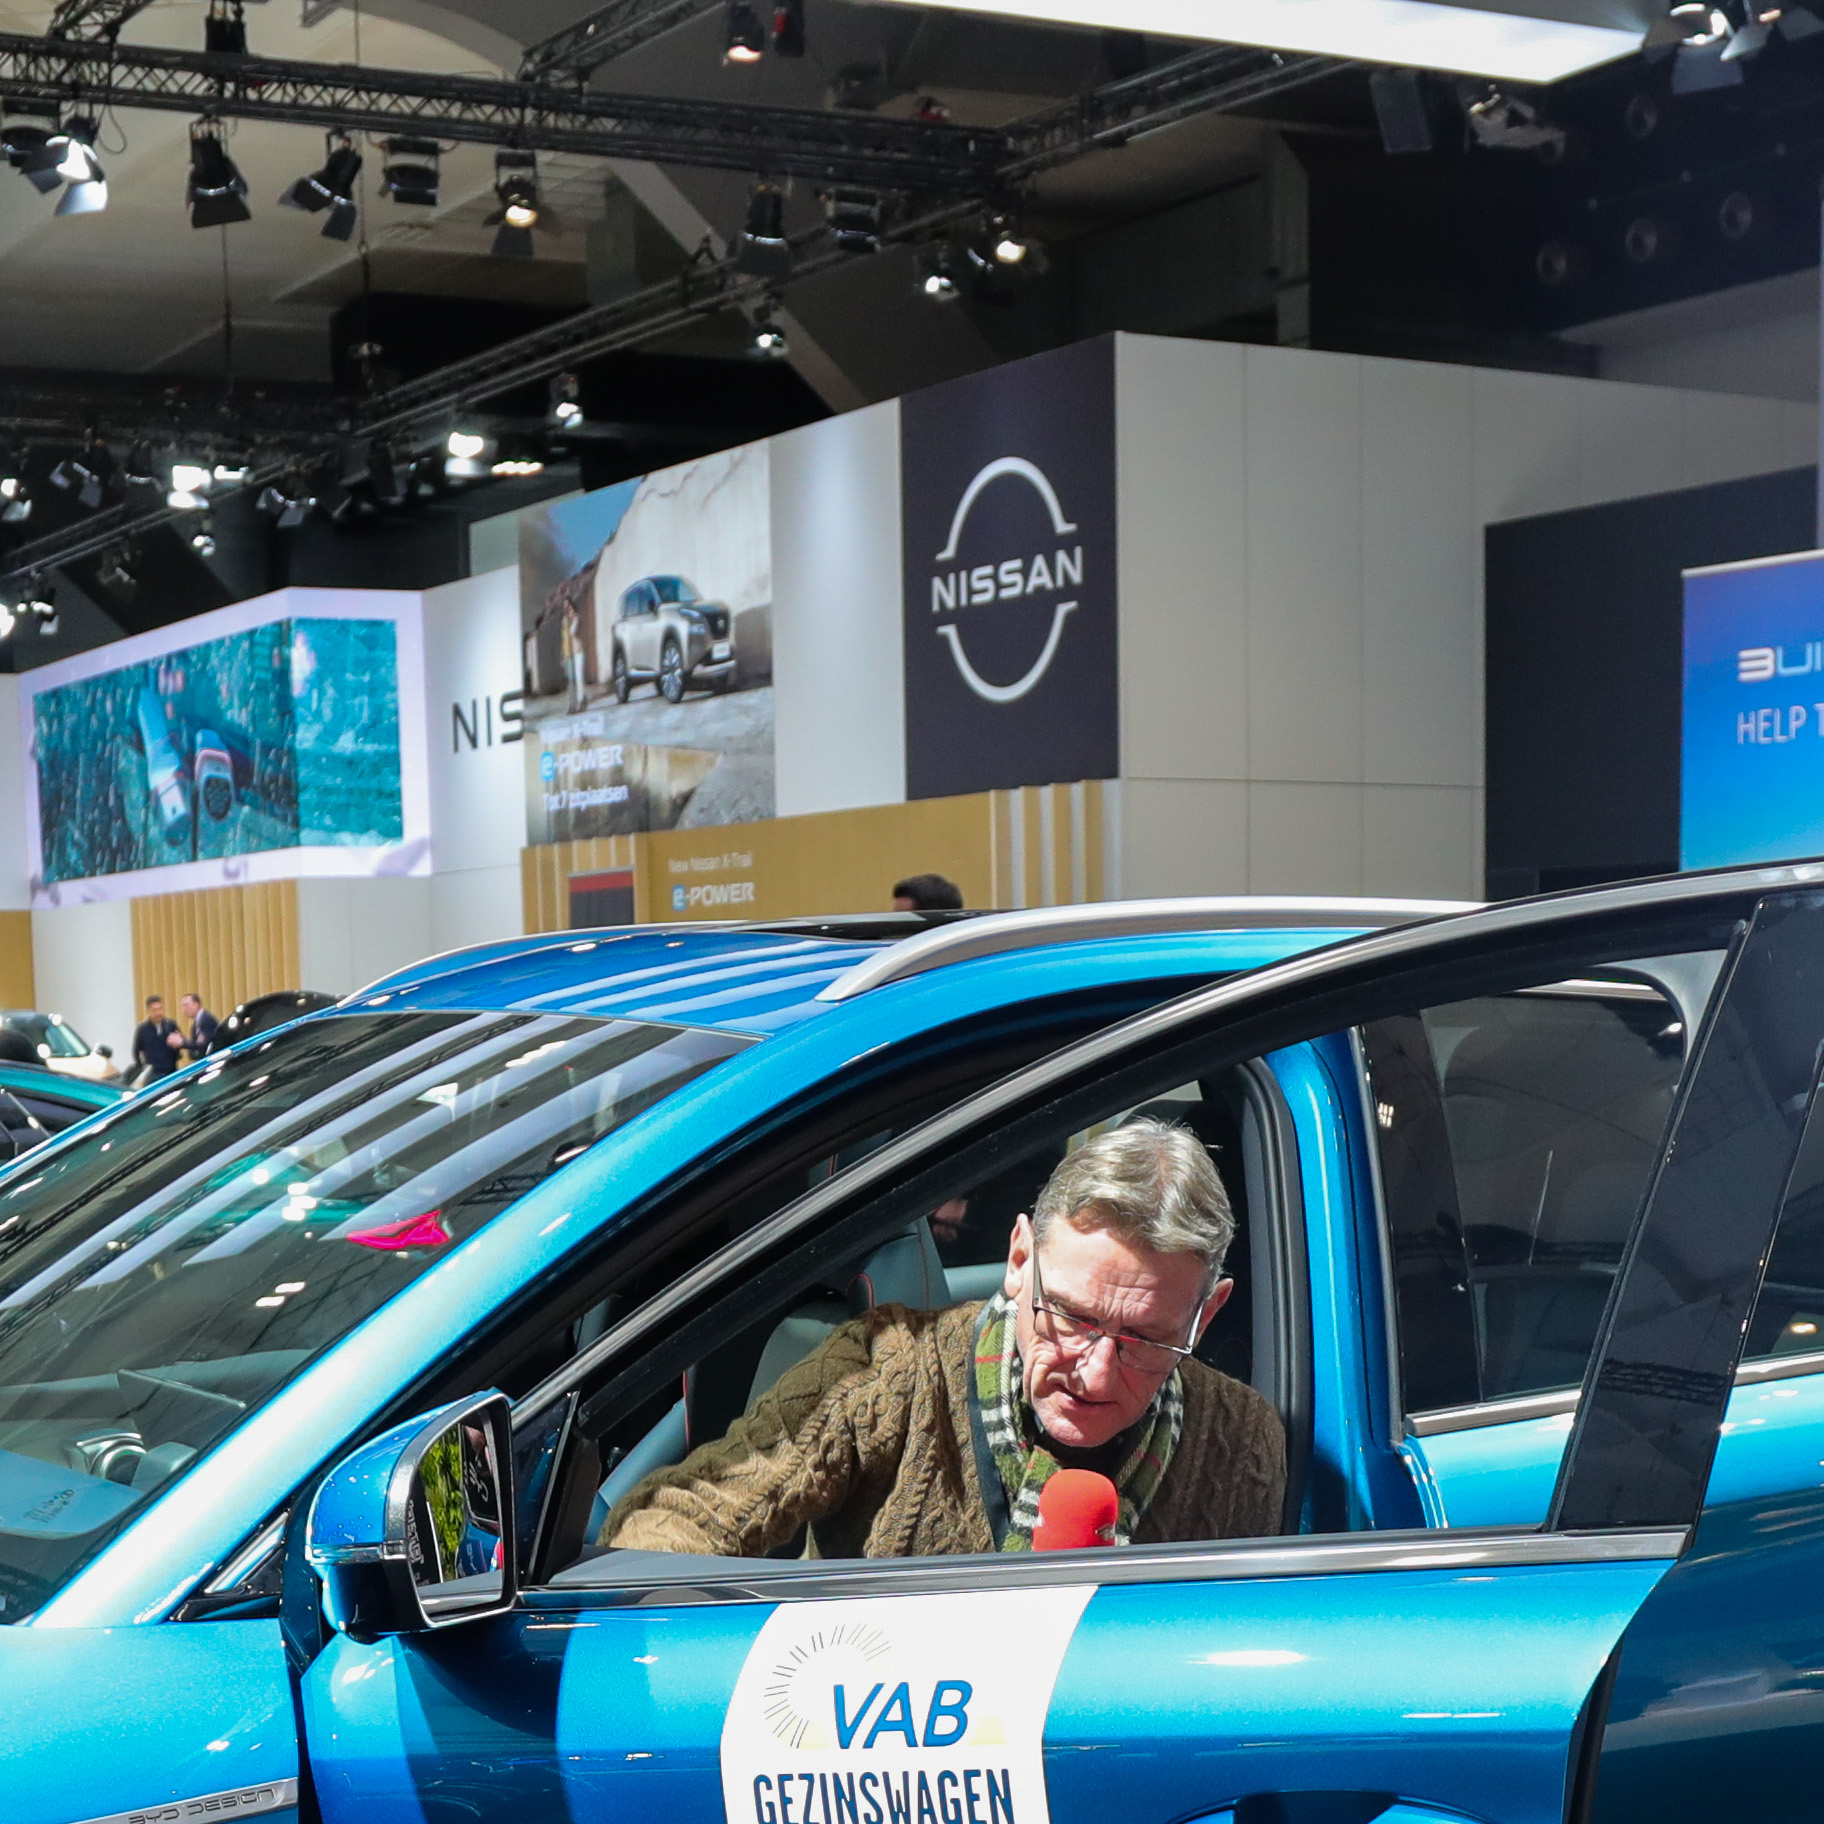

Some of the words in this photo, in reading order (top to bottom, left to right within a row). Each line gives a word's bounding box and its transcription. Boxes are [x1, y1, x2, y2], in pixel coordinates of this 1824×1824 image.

[931, 547, 1082, 613] NISSAN
[1737, 705, 1806, 744] HELP
[831, 1679, 973, 1749] VAB
[187, 1788, 275, 1815] DESIGN
